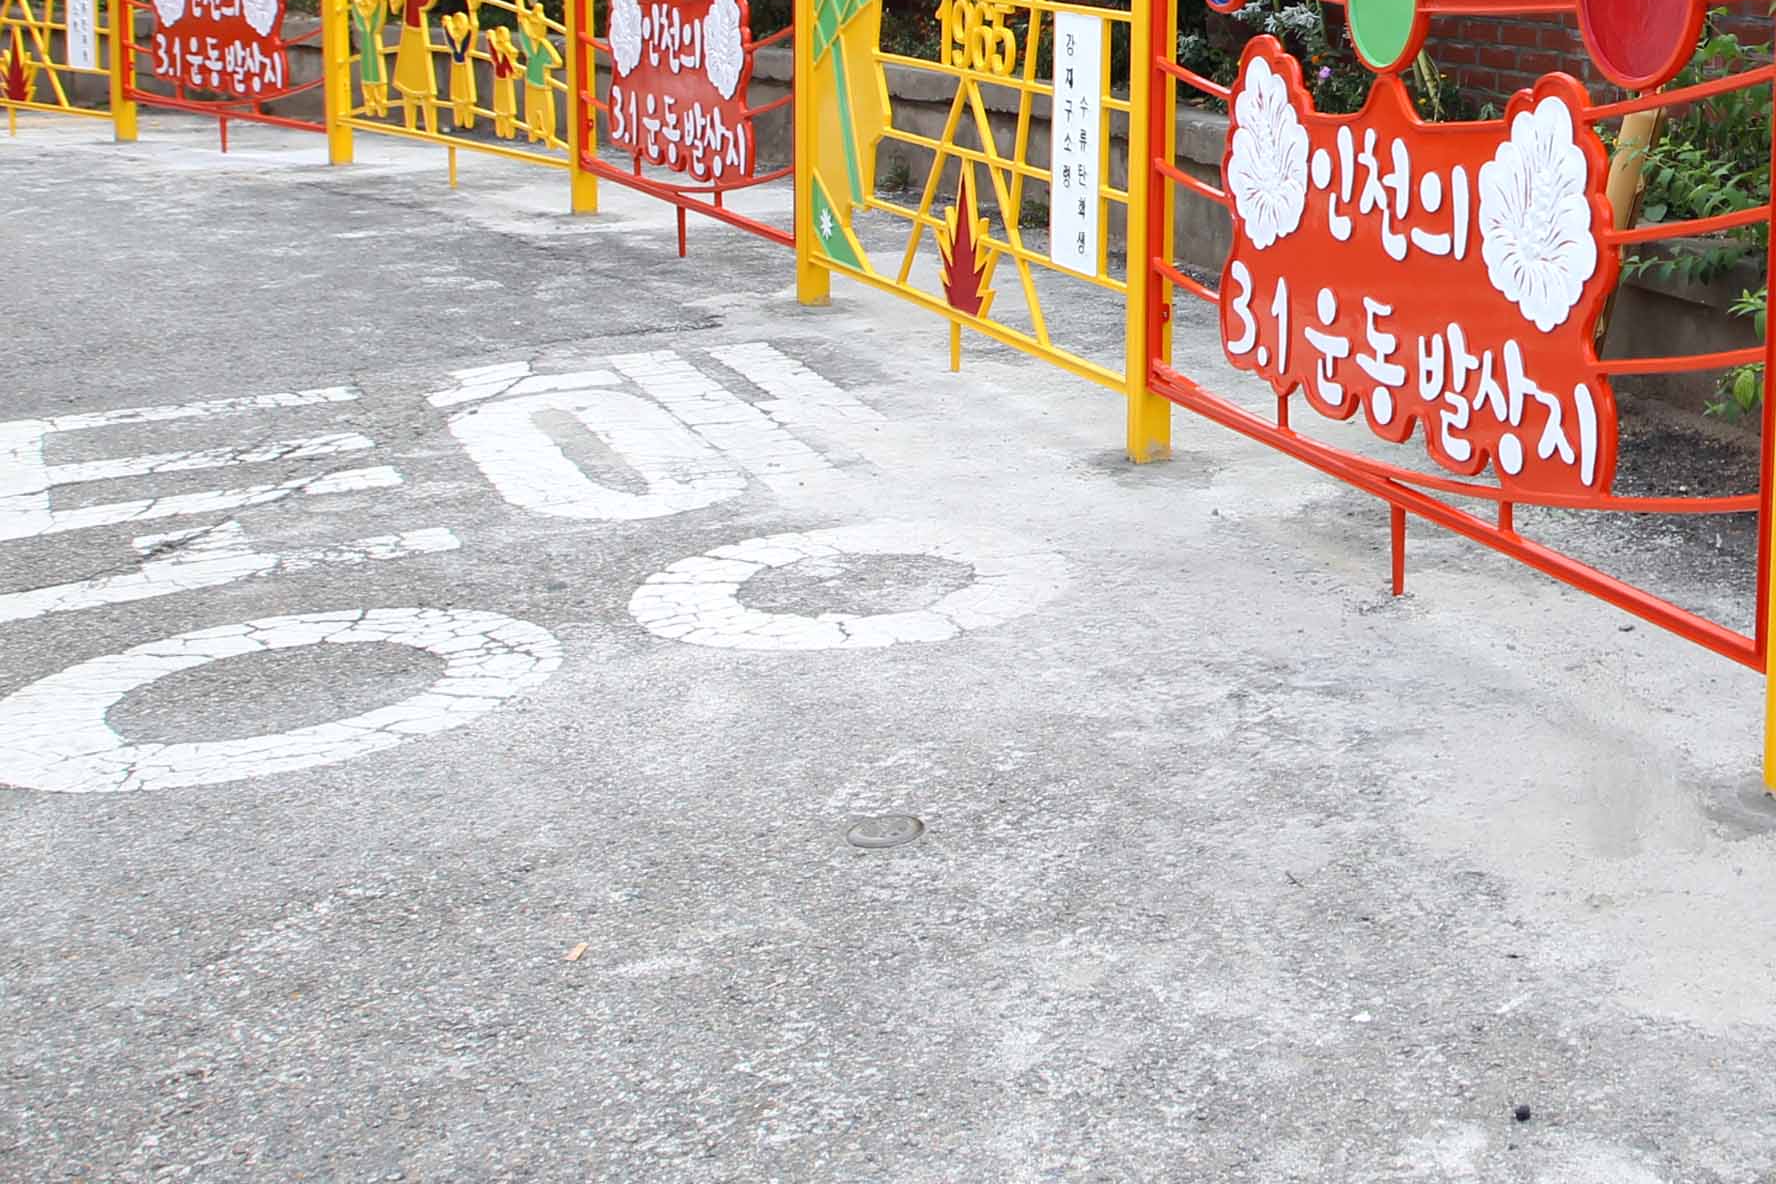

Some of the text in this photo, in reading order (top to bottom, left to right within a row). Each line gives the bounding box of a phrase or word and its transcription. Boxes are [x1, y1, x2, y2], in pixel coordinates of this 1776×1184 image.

[155, 32, 182, 77] 3.1
[642, 3, 701, 75] 인천의
[612, 85, 637, 146] 3.1
[1311, 124, 1471, 261] 인천의
[1227, 259, 1598, 487] 3.1 운동 발상지
